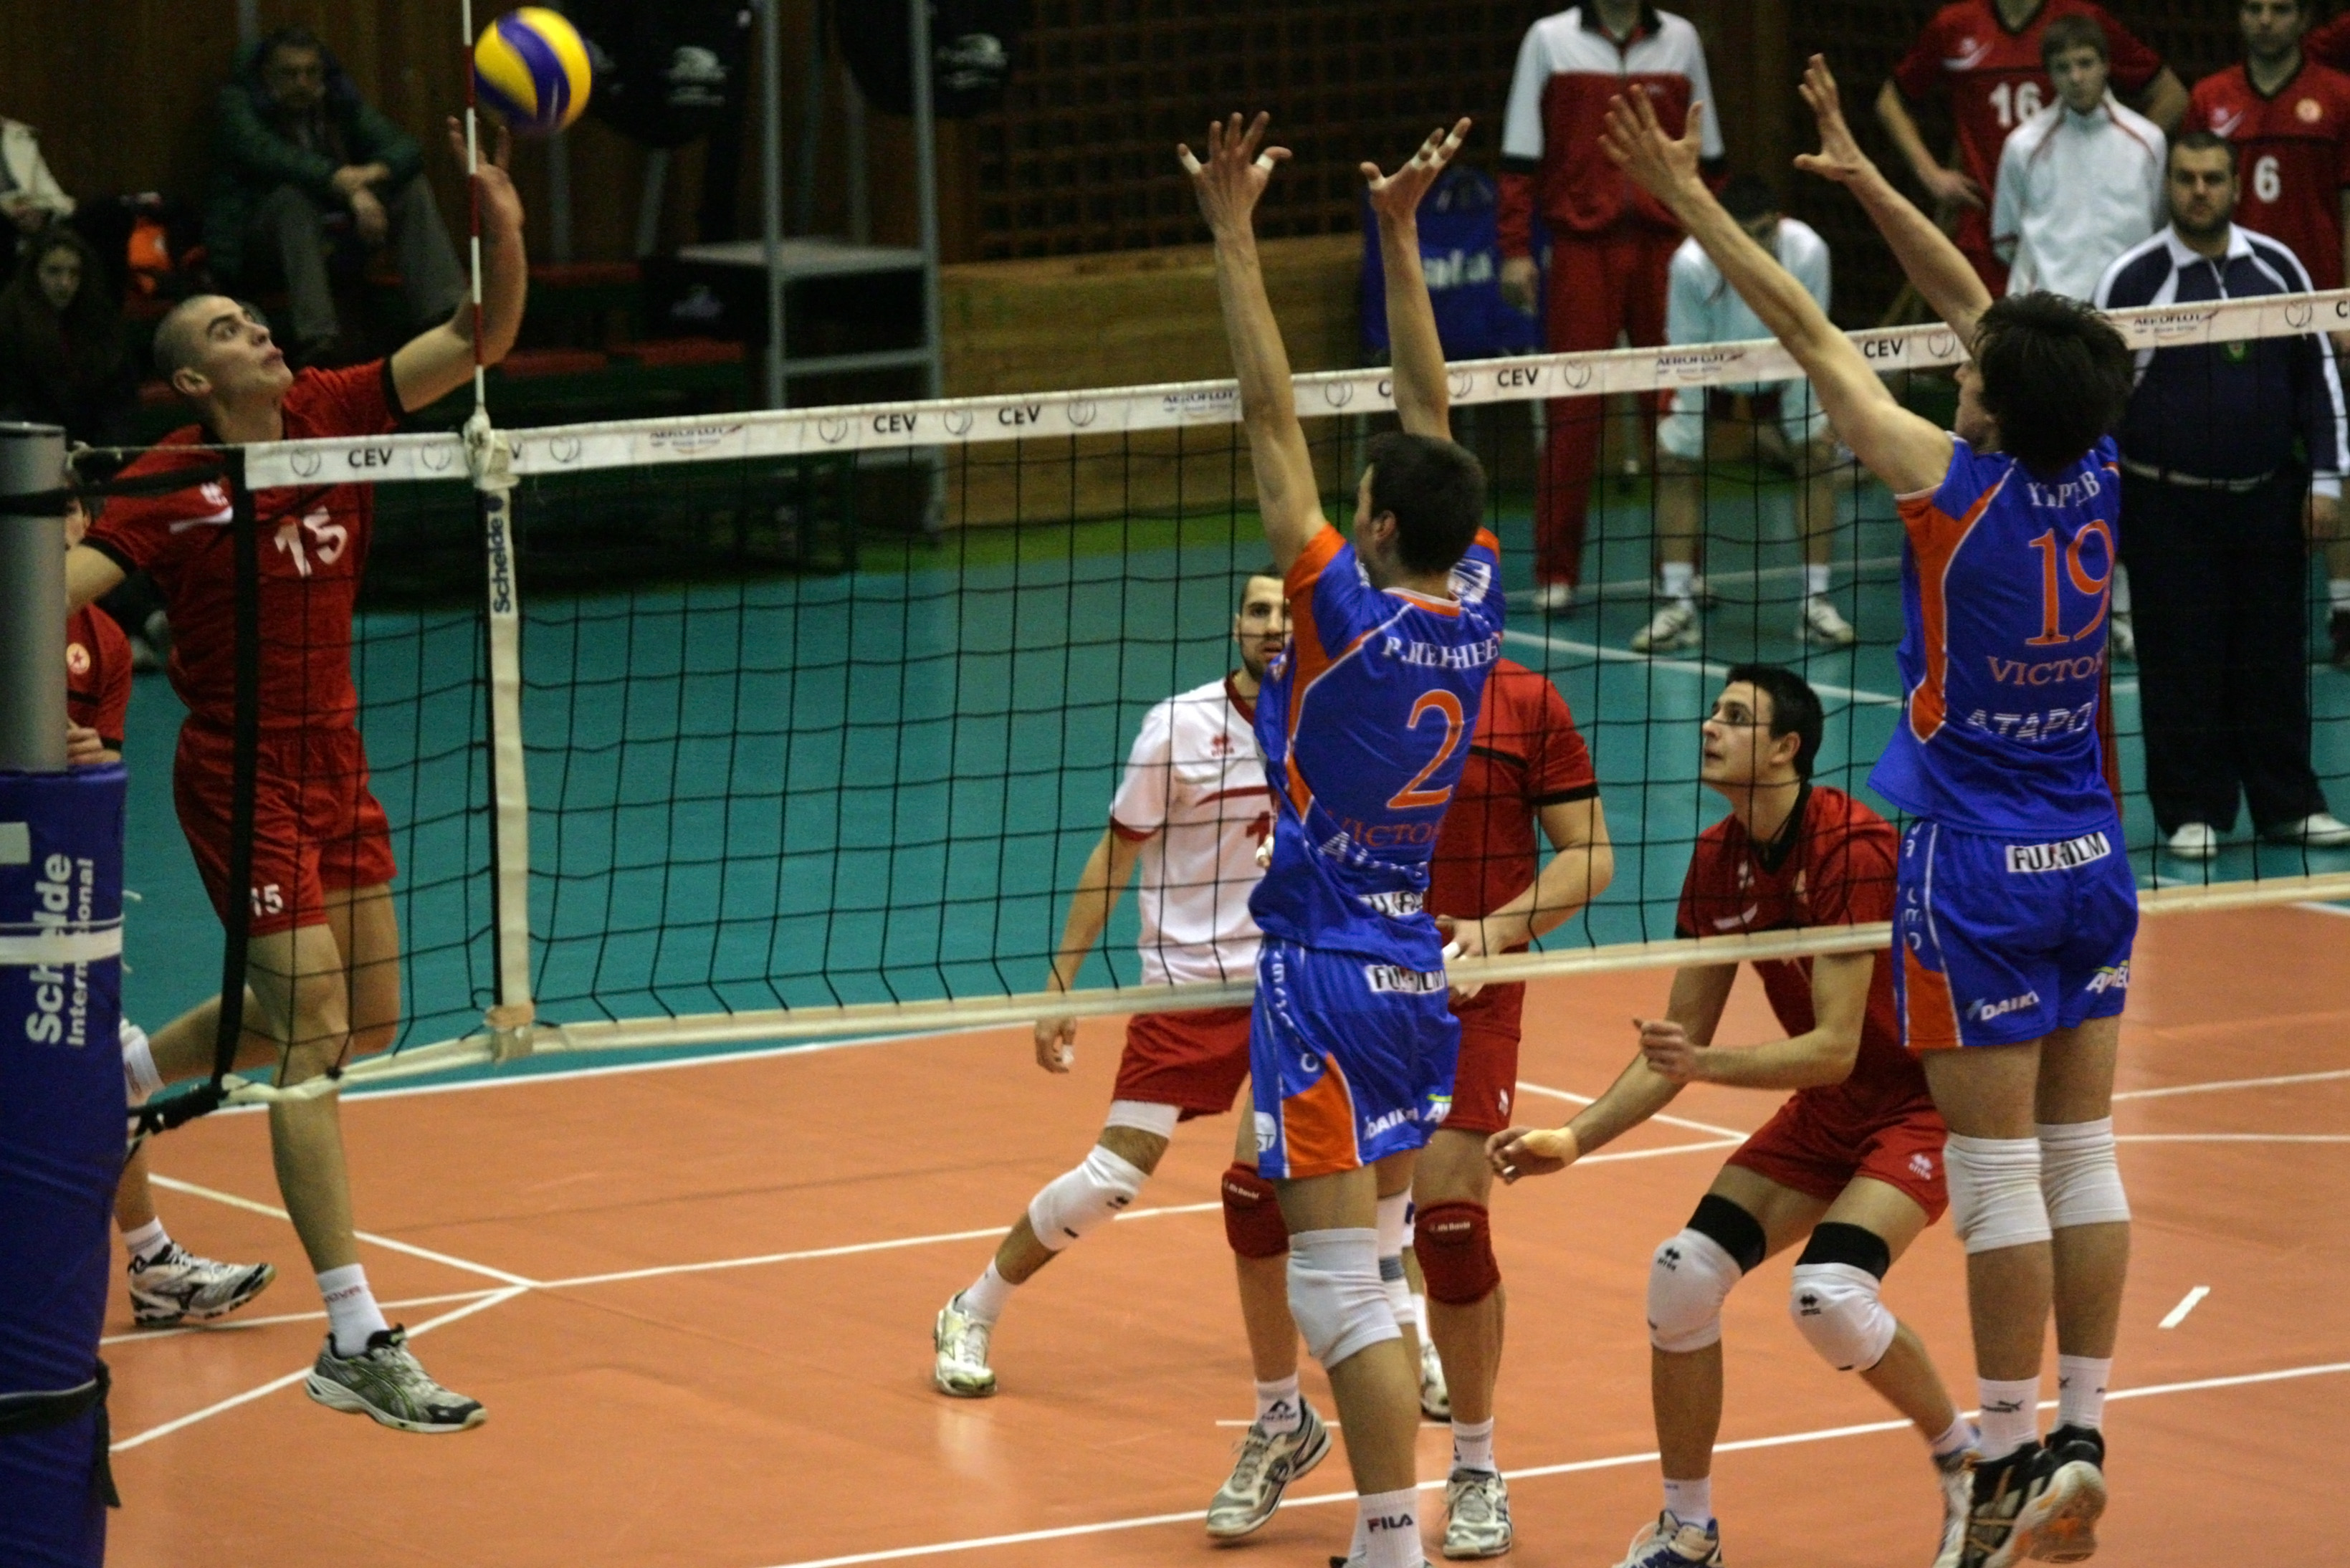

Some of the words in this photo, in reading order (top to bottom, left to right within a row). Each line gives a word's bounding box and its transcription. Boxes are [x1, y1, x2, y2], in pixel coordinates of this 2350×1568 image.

[1989, 81, 2043, 128] 16
[2254, 155, 2281, 205] 6
[1864, 338, 1904, 358] CEV
[1497, 367, 1539, 388] CEV
[873, 413, 917, 434] CEV
[998, 405, 1041, 426] CEV
[348, 447, 393, 469] CEV
[274, 505, 348, 578] 15
[487, 517, 511, 614] Schelde
[2025, 519, 2113, 645] 19
[1386, 688, 1465, 810] 2
[250, 883, 284, 917] 15
[26, 853, 72, 1045] Schlde
[1367, 1514, 1414, 1533] FILA
